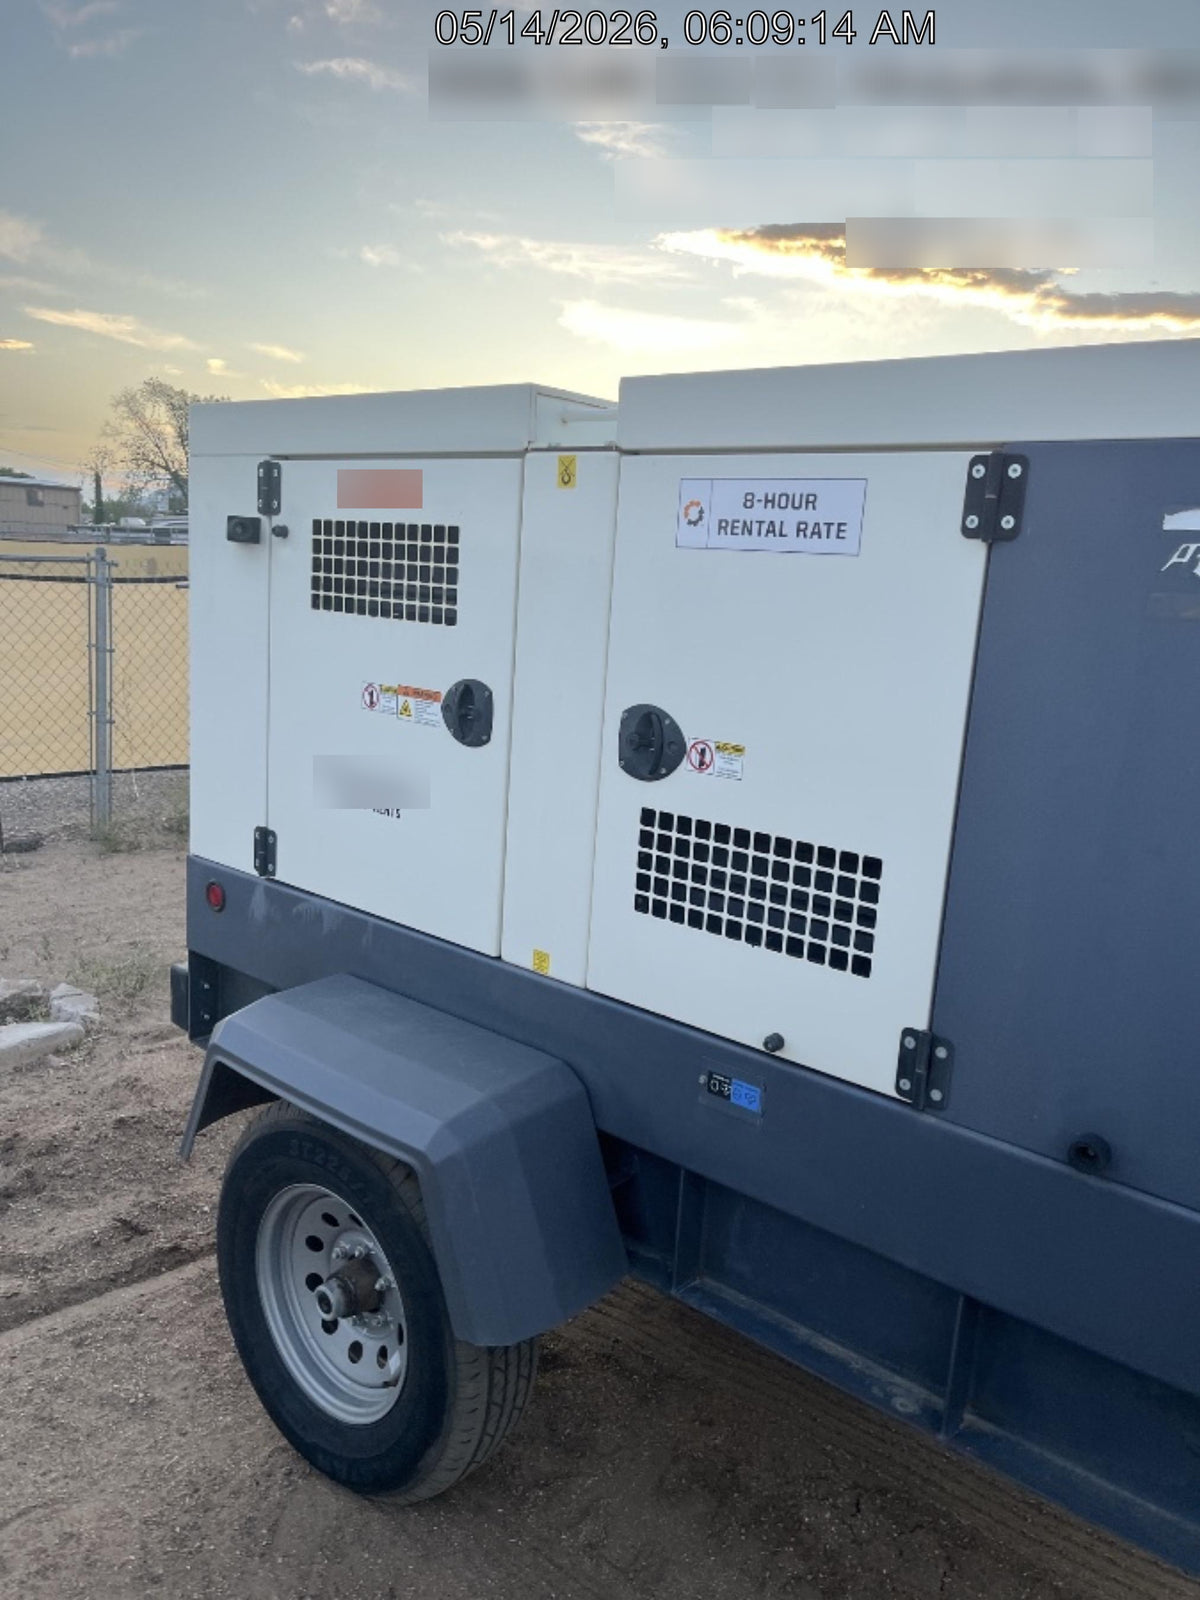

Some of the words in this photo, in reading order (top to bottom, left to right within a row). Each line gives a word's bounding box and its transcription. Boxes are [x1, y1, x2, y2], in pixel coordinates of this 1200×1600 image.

[742, 492, 818, 511] 8-HOUR
[717, 519, 789, 538] RENTAL
[795, 521, 848, 539] RATE
